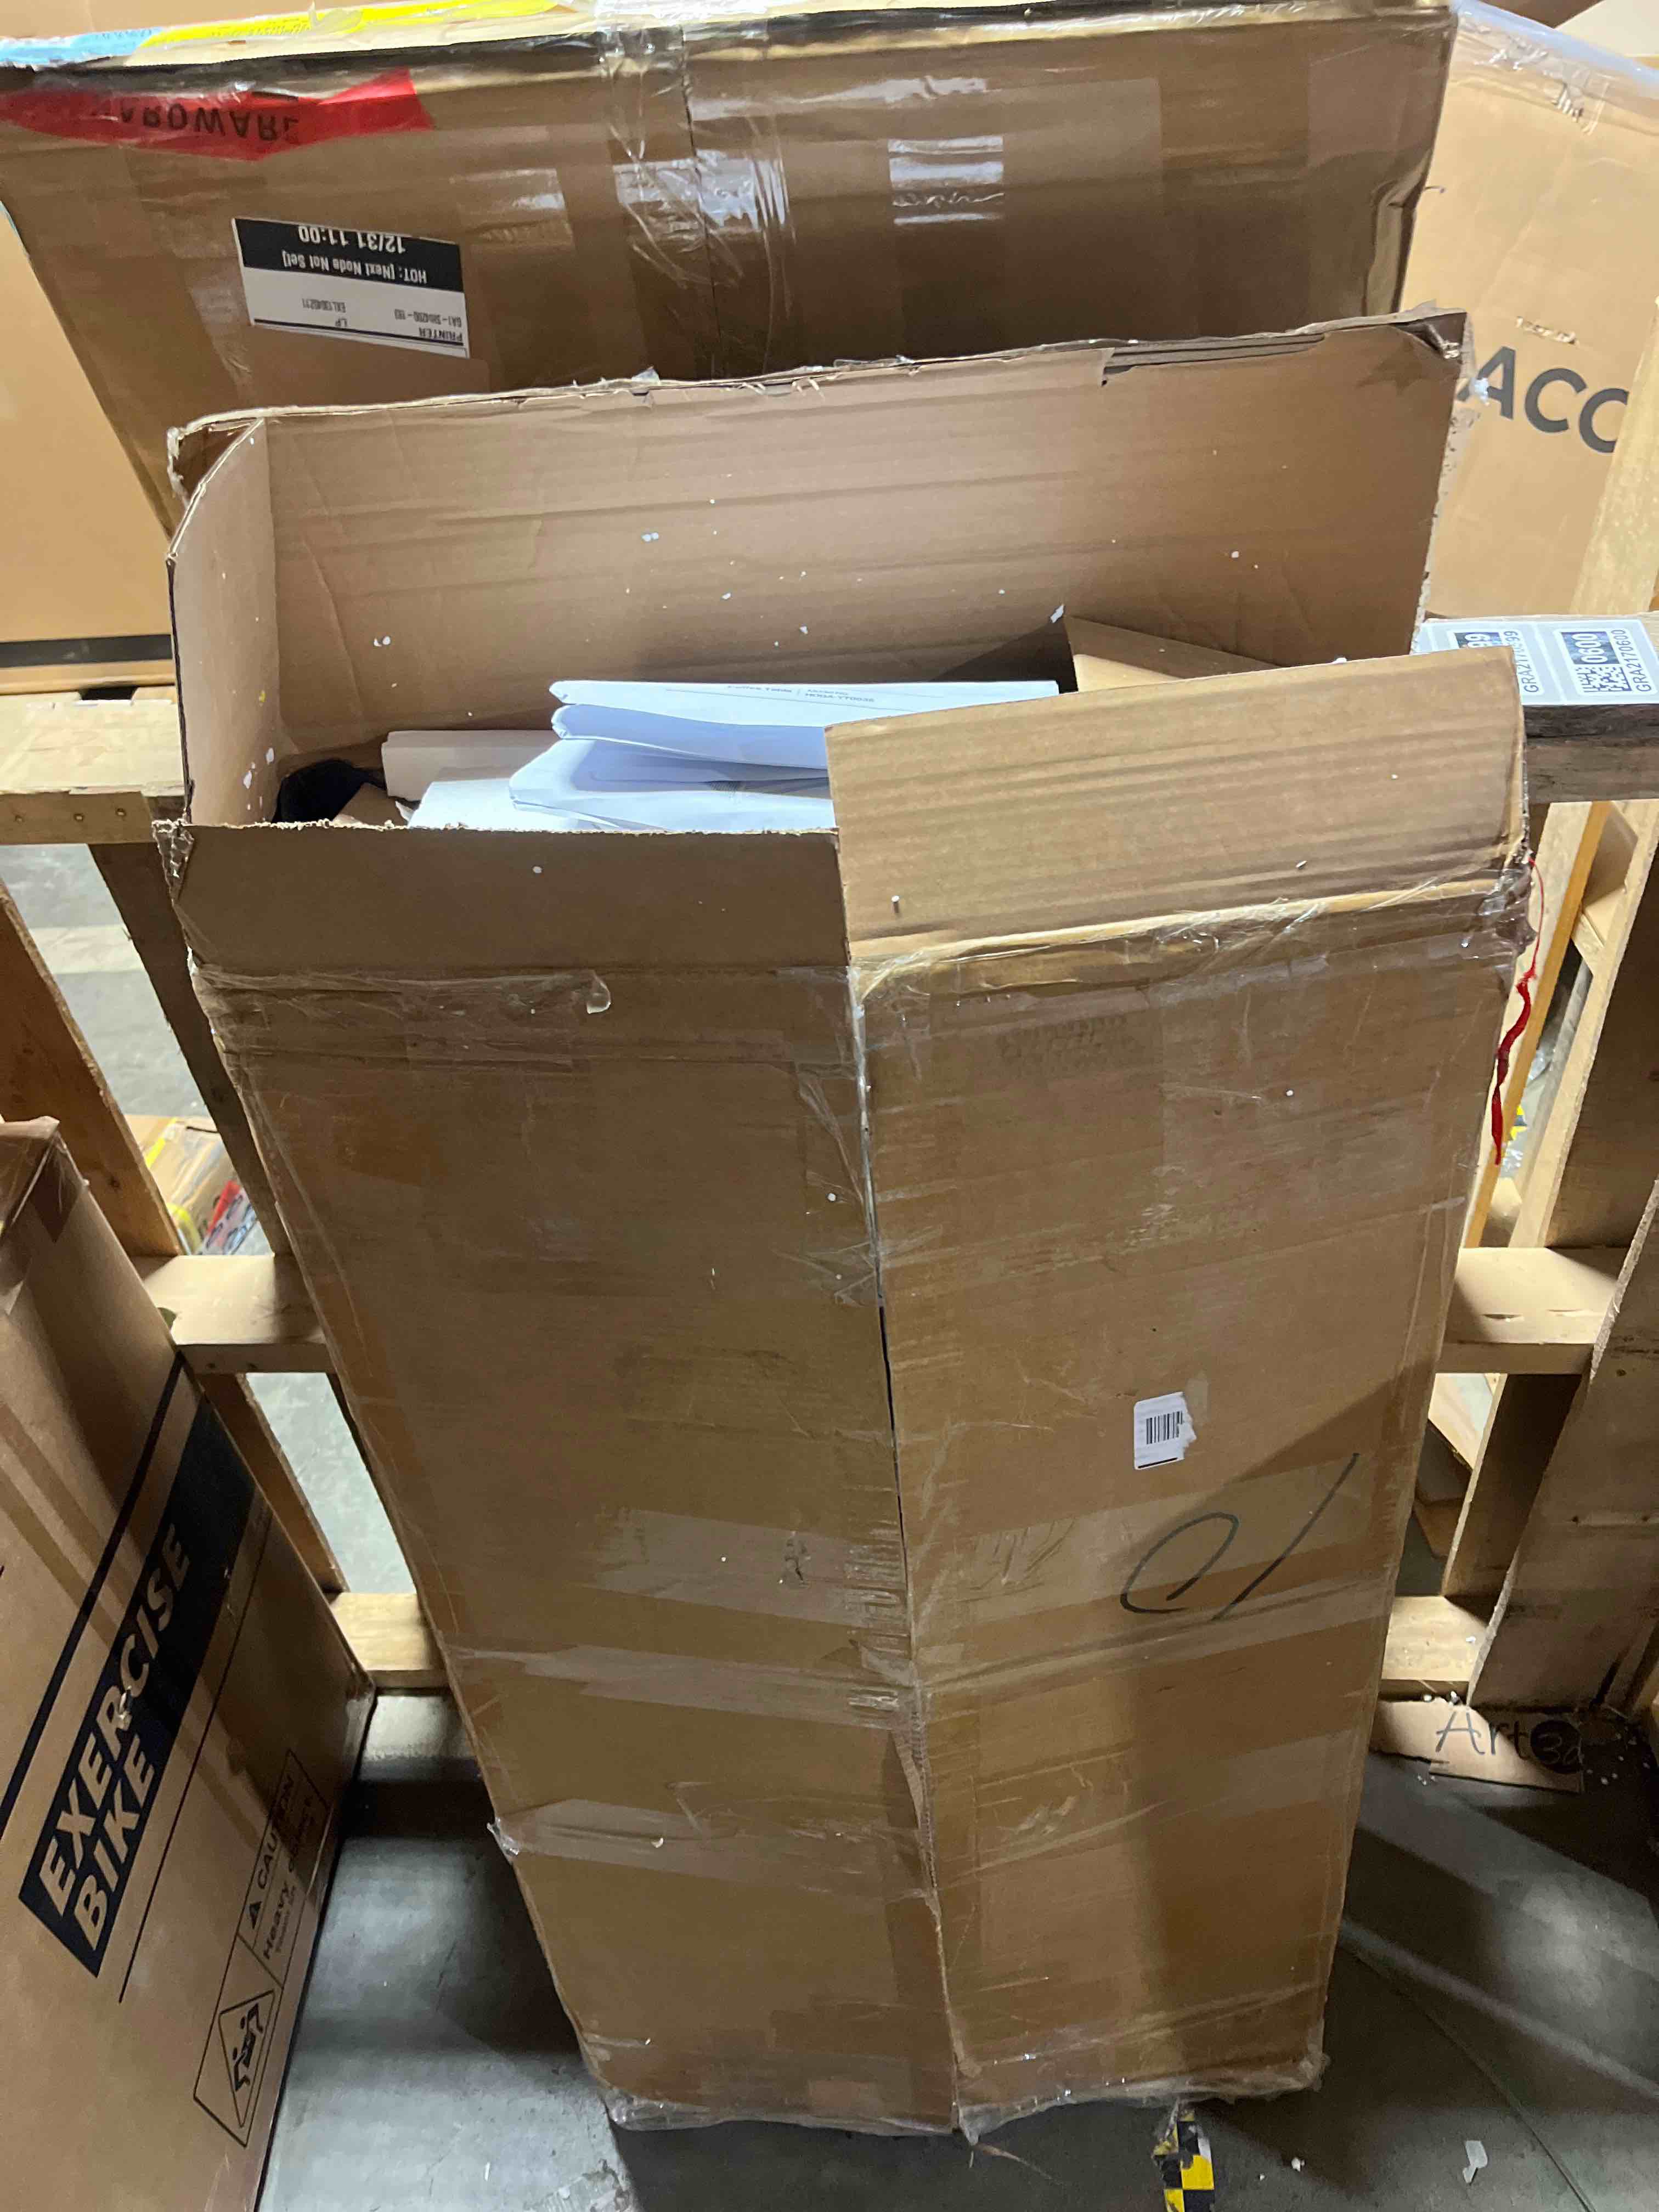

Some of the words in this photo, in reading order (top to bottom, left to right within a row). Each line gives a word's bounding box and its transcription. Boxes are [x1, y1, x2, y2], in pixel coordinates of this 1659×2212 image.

[298, 225, 349, 246] 11:00
[356, 232, 407, 254] 12/31
[309, 255, 329, 272] Not
[332, 258, 362, 275] Node
[365, 262, 395, 280] [Next
[399, 267, 427, 284] HOT:
[418, 328, 463, 342] PRINTER
[1571, 633, 1609, 664] 0600
[1610, 629, 1652, 692] GRA2170600
[39, 1523, 189, 1916] EXERCISE
[74, 1734, 155, 1951] BIKE
[263, 1882, 290, 1960] Heavy
